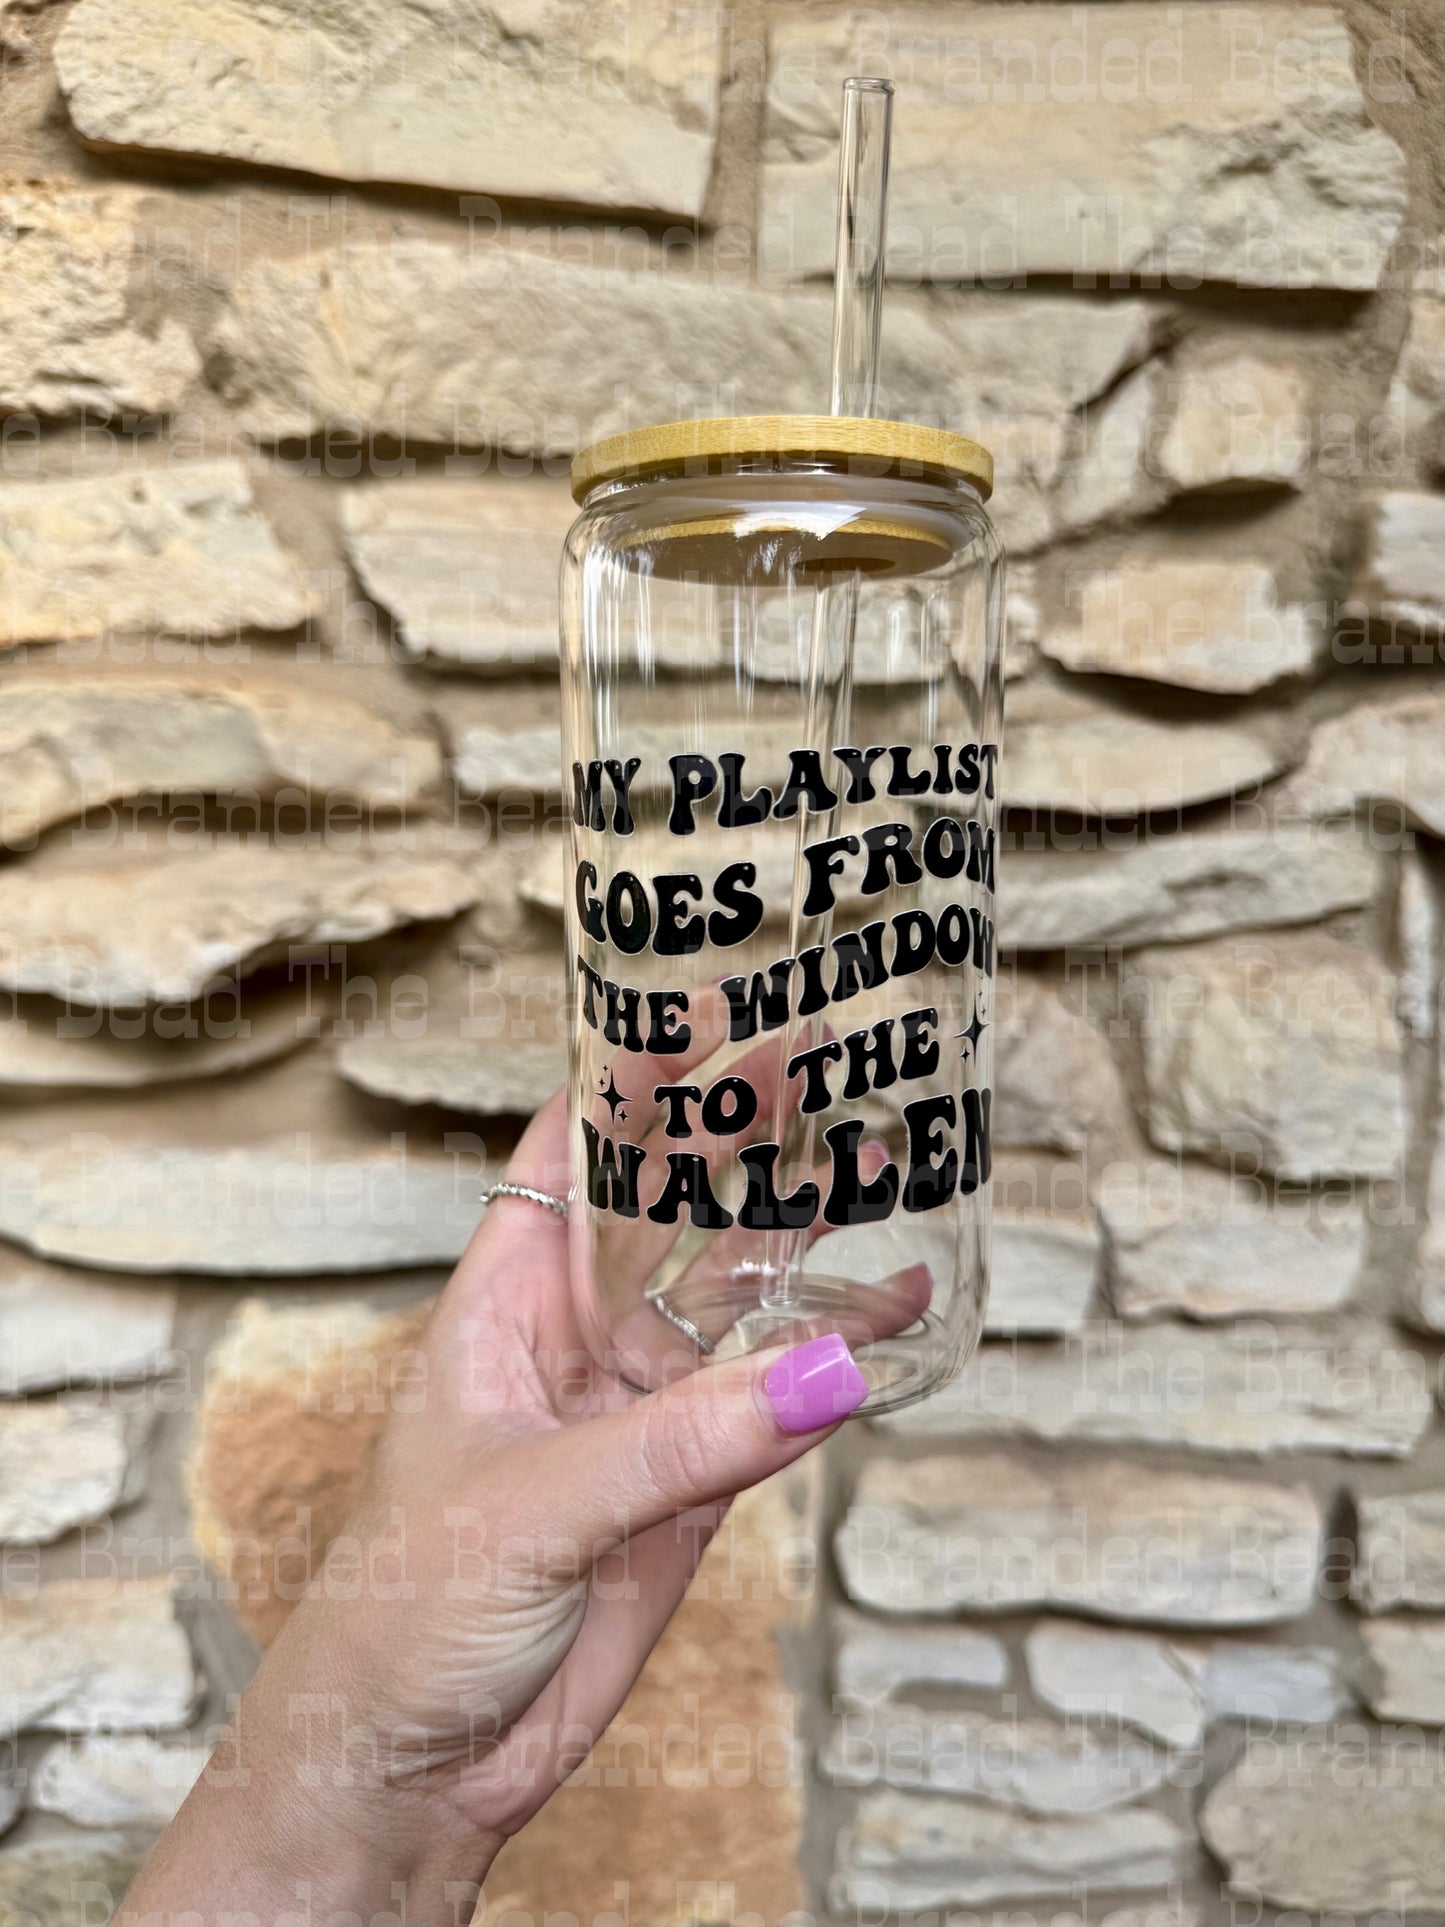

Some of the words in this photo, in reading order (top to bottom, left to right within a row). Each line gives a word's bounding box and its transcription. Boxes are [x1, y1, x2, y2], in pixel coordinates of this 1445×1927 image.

[572, 757, 641, 836] MY
[667, 744, 998, 836] PLAYLIST
[576, 859, 764, 956] GOES
[802, 817, 996, 917] FROM
[577, 954, 692, 1055] THE
[720, 904, 995, 1042] WINDOW
[654, 1074, 758, 1138] TO
[787, 1007, 940, 1115] THE
[581, 1087, 992, 1230] WALLEN
